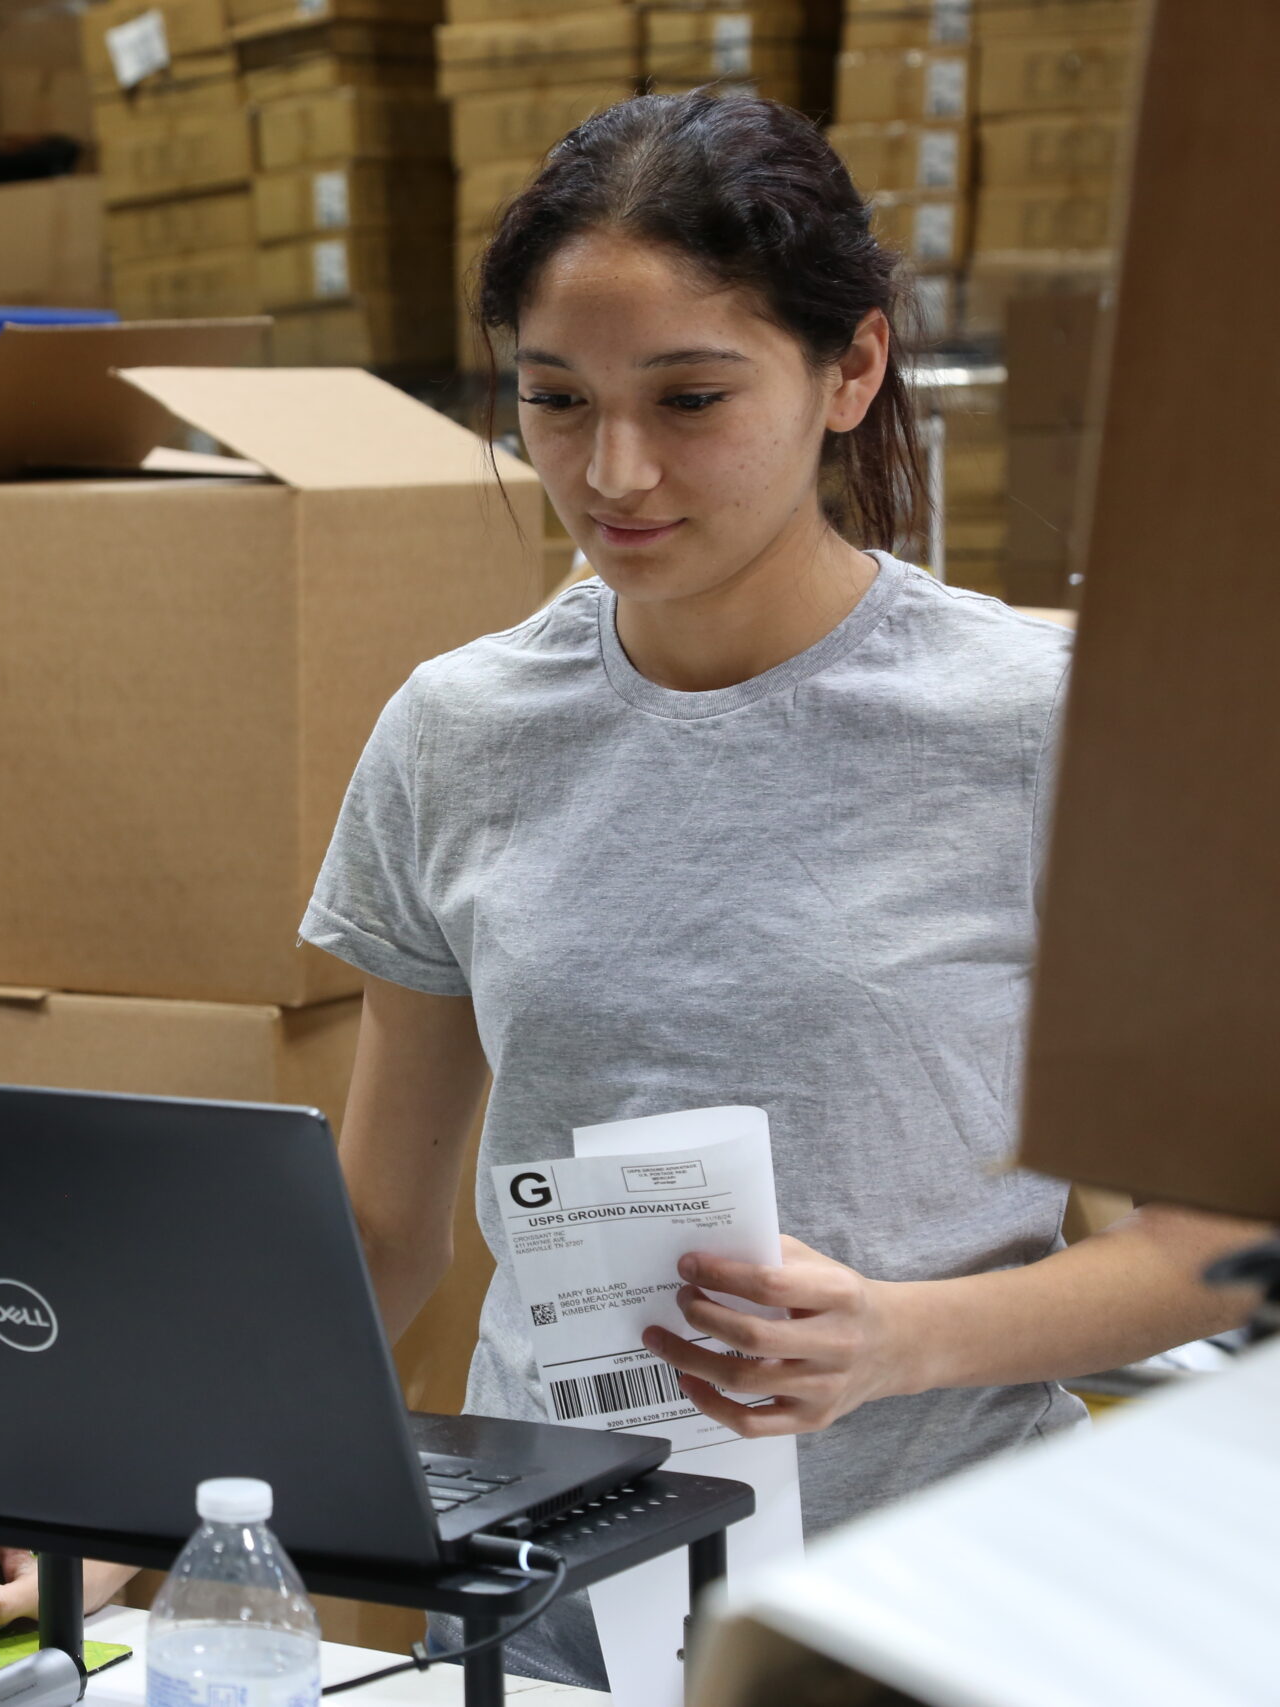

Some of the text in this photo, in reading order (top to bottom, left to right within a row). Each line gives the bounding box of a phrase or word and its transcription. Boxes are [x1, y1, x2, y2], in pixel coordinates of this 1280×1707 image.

[510, 1172, 553, 1209] G
[528, 1200, 711, 1227] USPS GROUND ADVANTAGE
[513, 1232, 552, 1243] CROISSANT
[515, 1244, 552, 1255] NASHVILLE
[558, 1282, 628, 1300] MARY BALLARD
[560, 1282, 683, 1309] 9609 MEADOW RIDGE PKWY
[562, 1296, 647, 1317] KIMBERLY AL 35091
[613, 1352, 656, 1365] USPS TRAC
[607, 1420, 624, 1428] 9200
[626, 1416, 642, 1425] 1903
[662, 1410, 678, 1419] 7730
